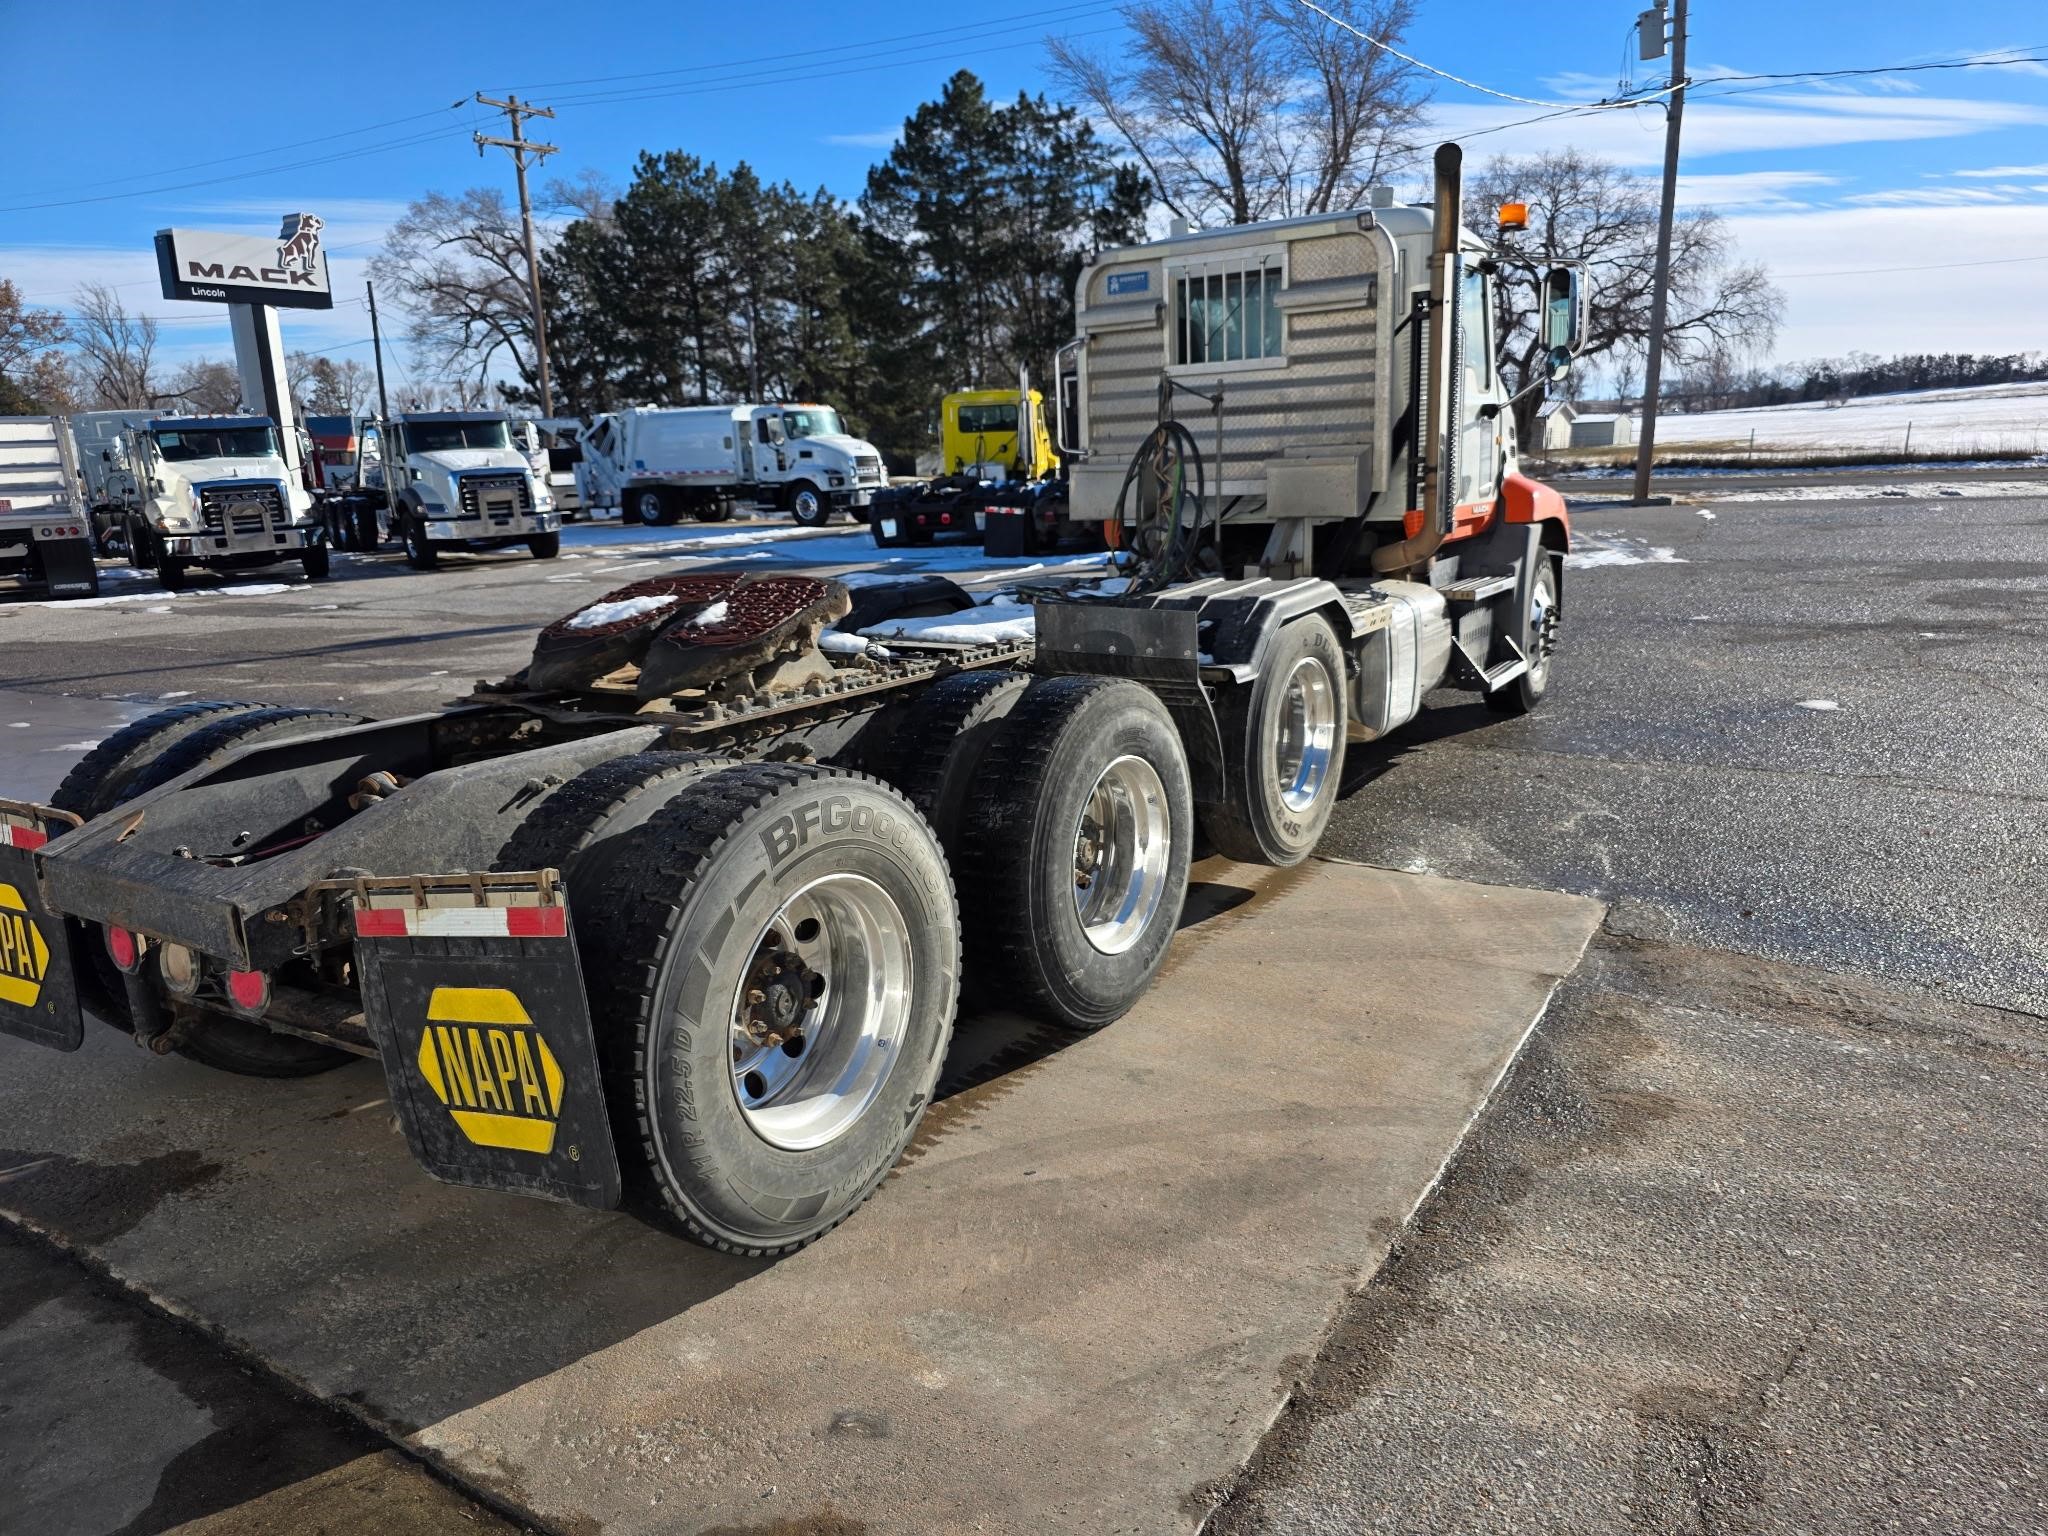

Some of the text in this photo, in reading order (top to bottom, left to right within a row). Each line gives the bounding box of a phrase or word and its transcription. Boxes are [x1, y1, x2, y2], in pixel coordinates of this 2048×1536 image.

[189, 261, 318, 286] MACK
[191, 287, 226, 298] Lincoln
[0, 912, 36, 979] PA
[437, 1026, 548, 1116] NAPA
[671, 1055, 698, 1121] 22.5
